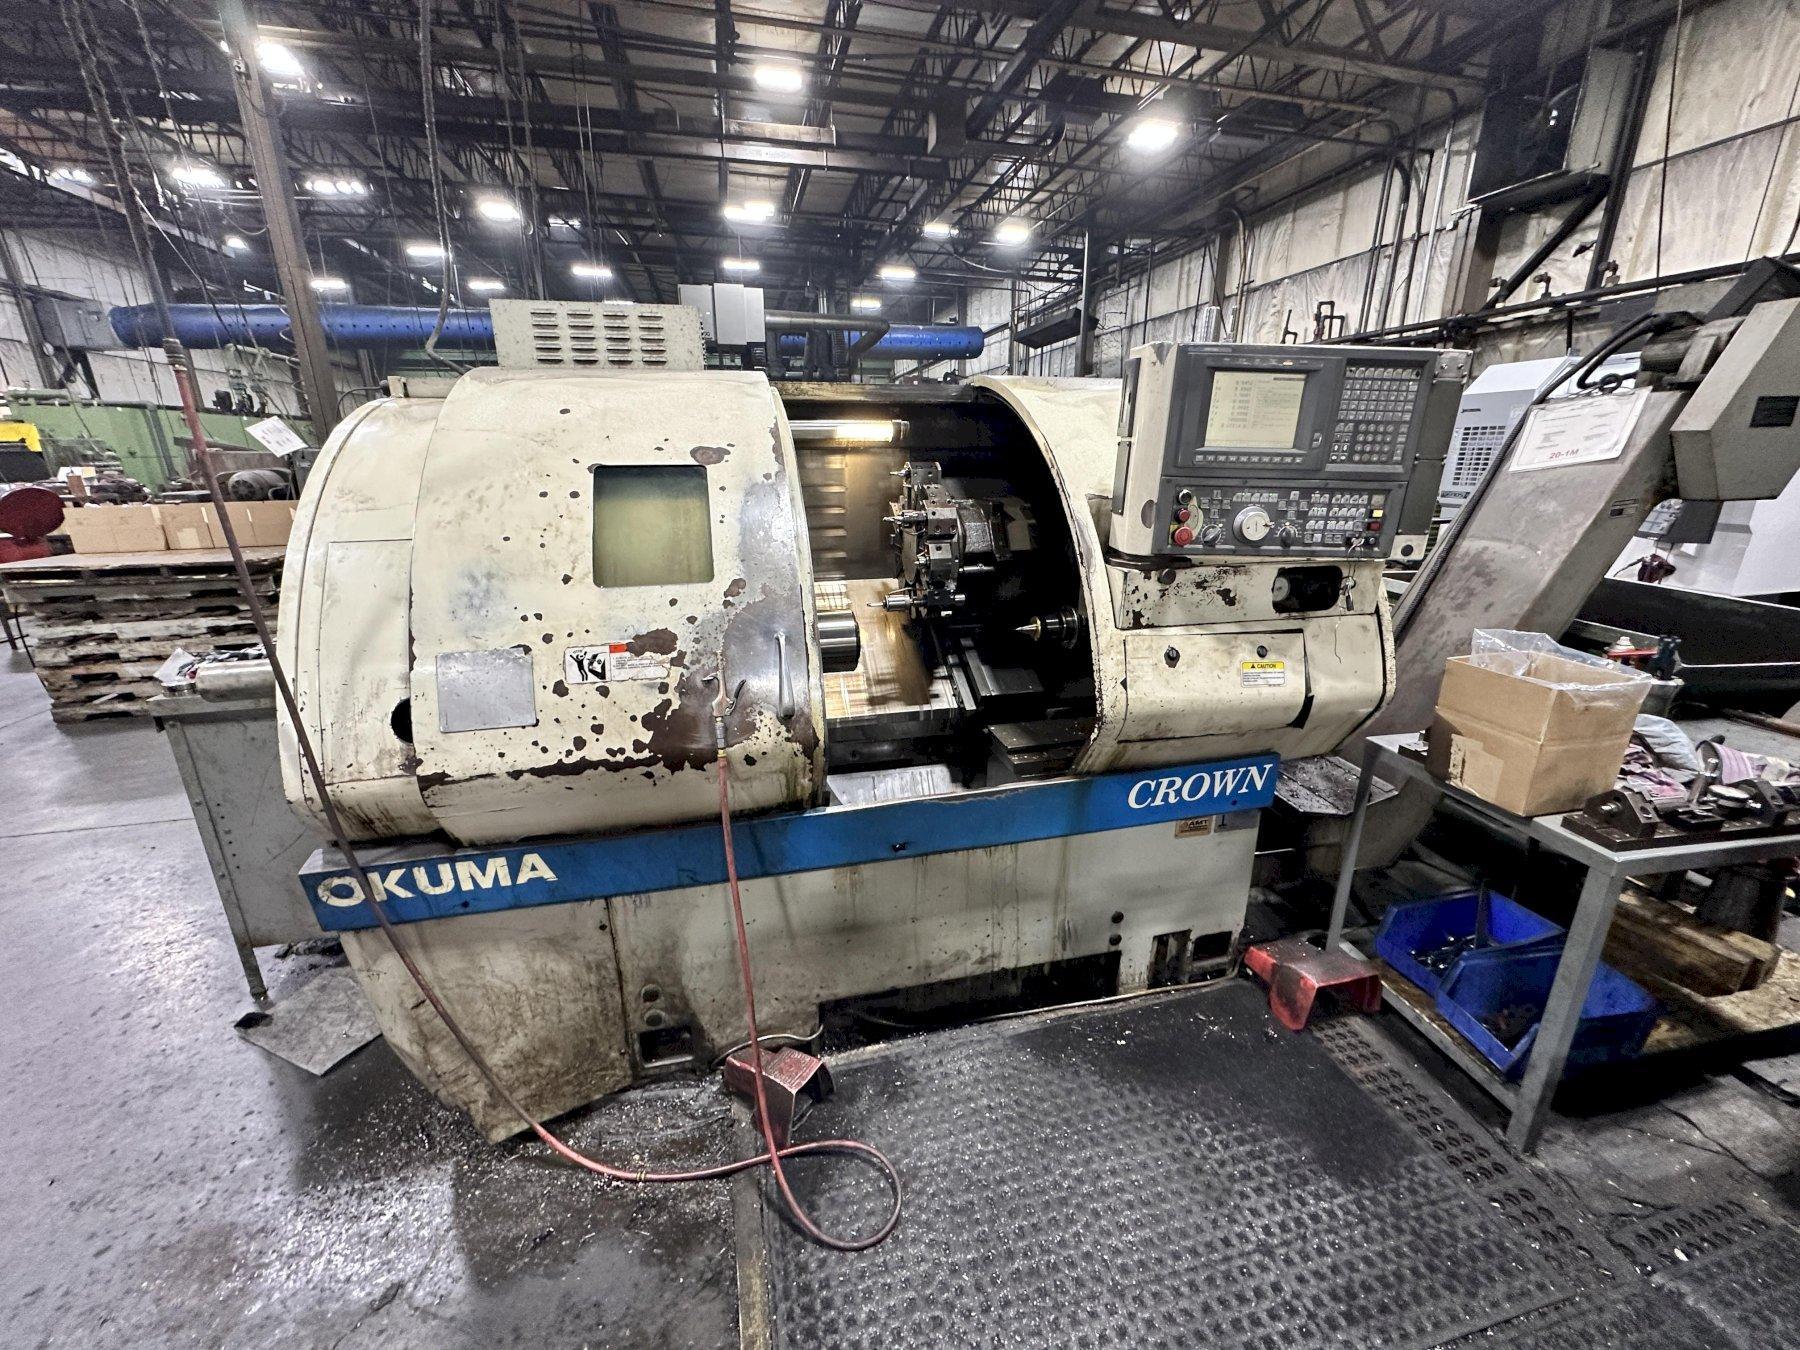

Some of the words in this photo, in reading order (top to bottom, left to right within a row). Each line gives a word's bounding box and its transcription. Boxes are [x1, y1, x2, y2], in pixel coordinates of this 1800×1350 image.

[1549, 448, 1579, 459] 20-1M
[1128, 764, 1273, 808] CROWN
[317, 853, 558, 907] OKUMA
